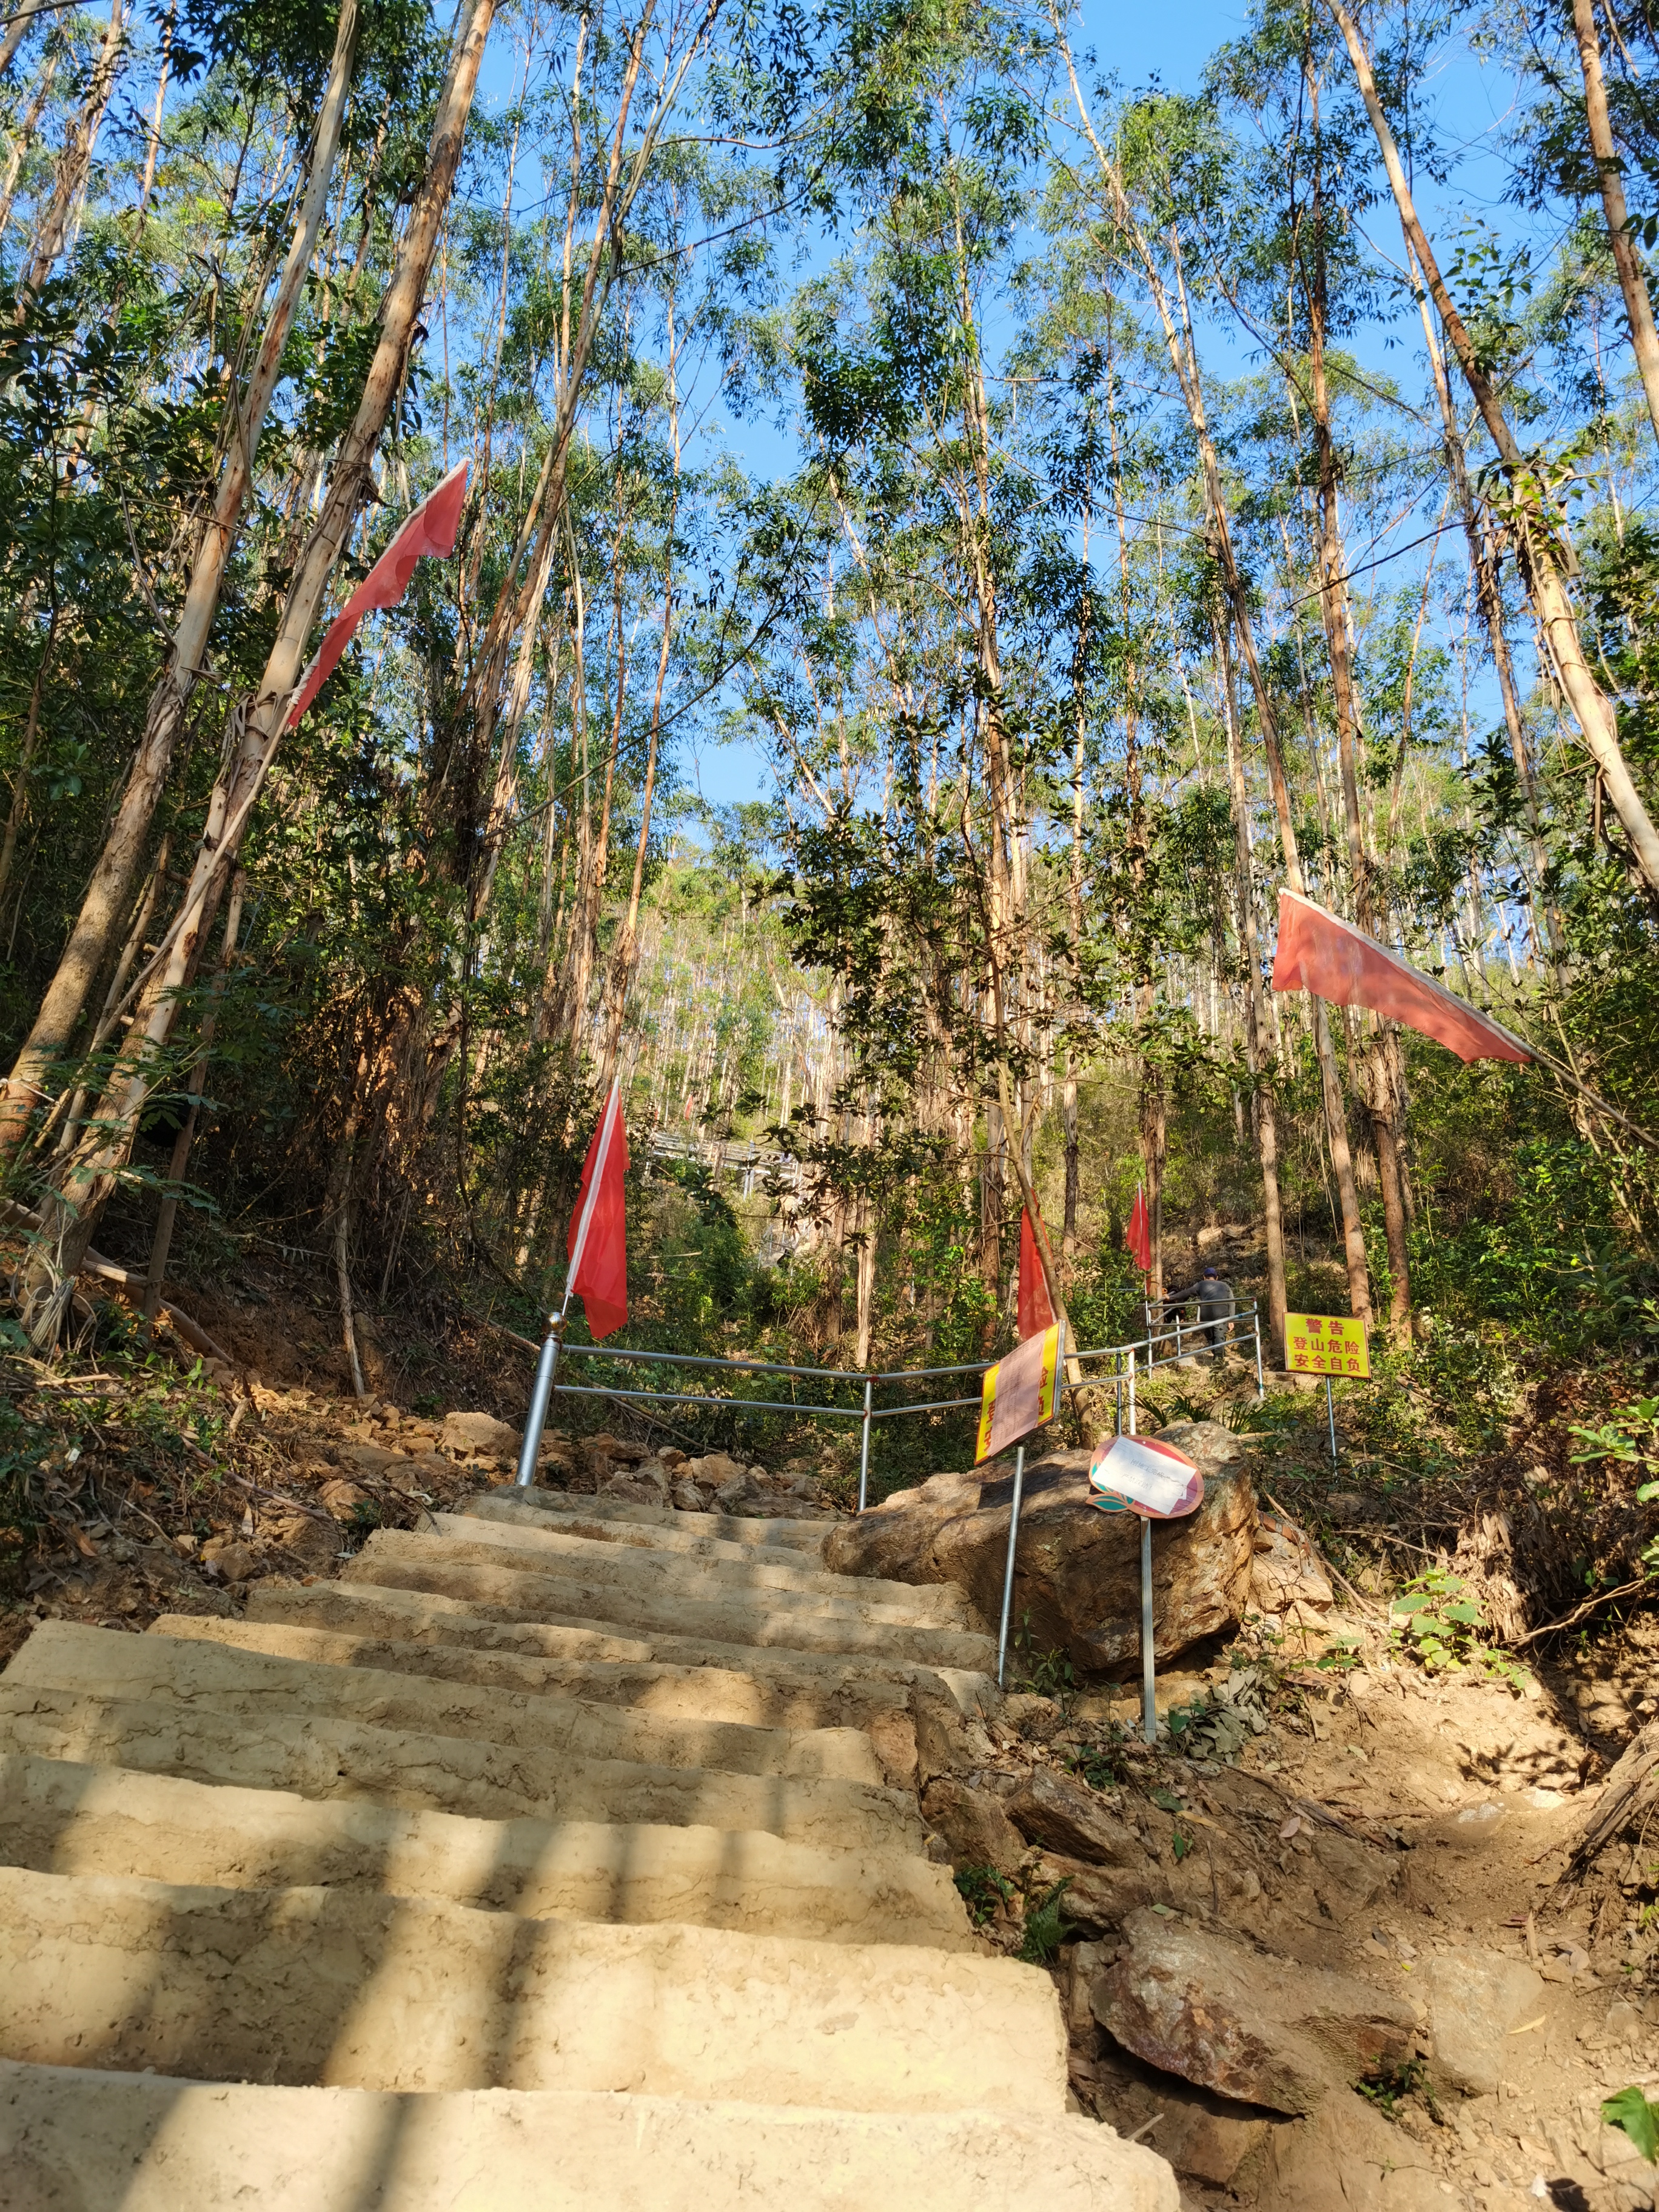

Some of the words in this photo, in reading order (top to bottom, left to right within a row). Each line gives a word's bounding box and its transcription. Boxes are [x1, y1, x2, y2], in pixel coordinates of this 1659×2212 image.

[1305, 1318, 1344, 1336] 警告
[1293, 1336, 1360, 1355] 登山危险
[1294, 1353, 1361, 1372] 安全自负
